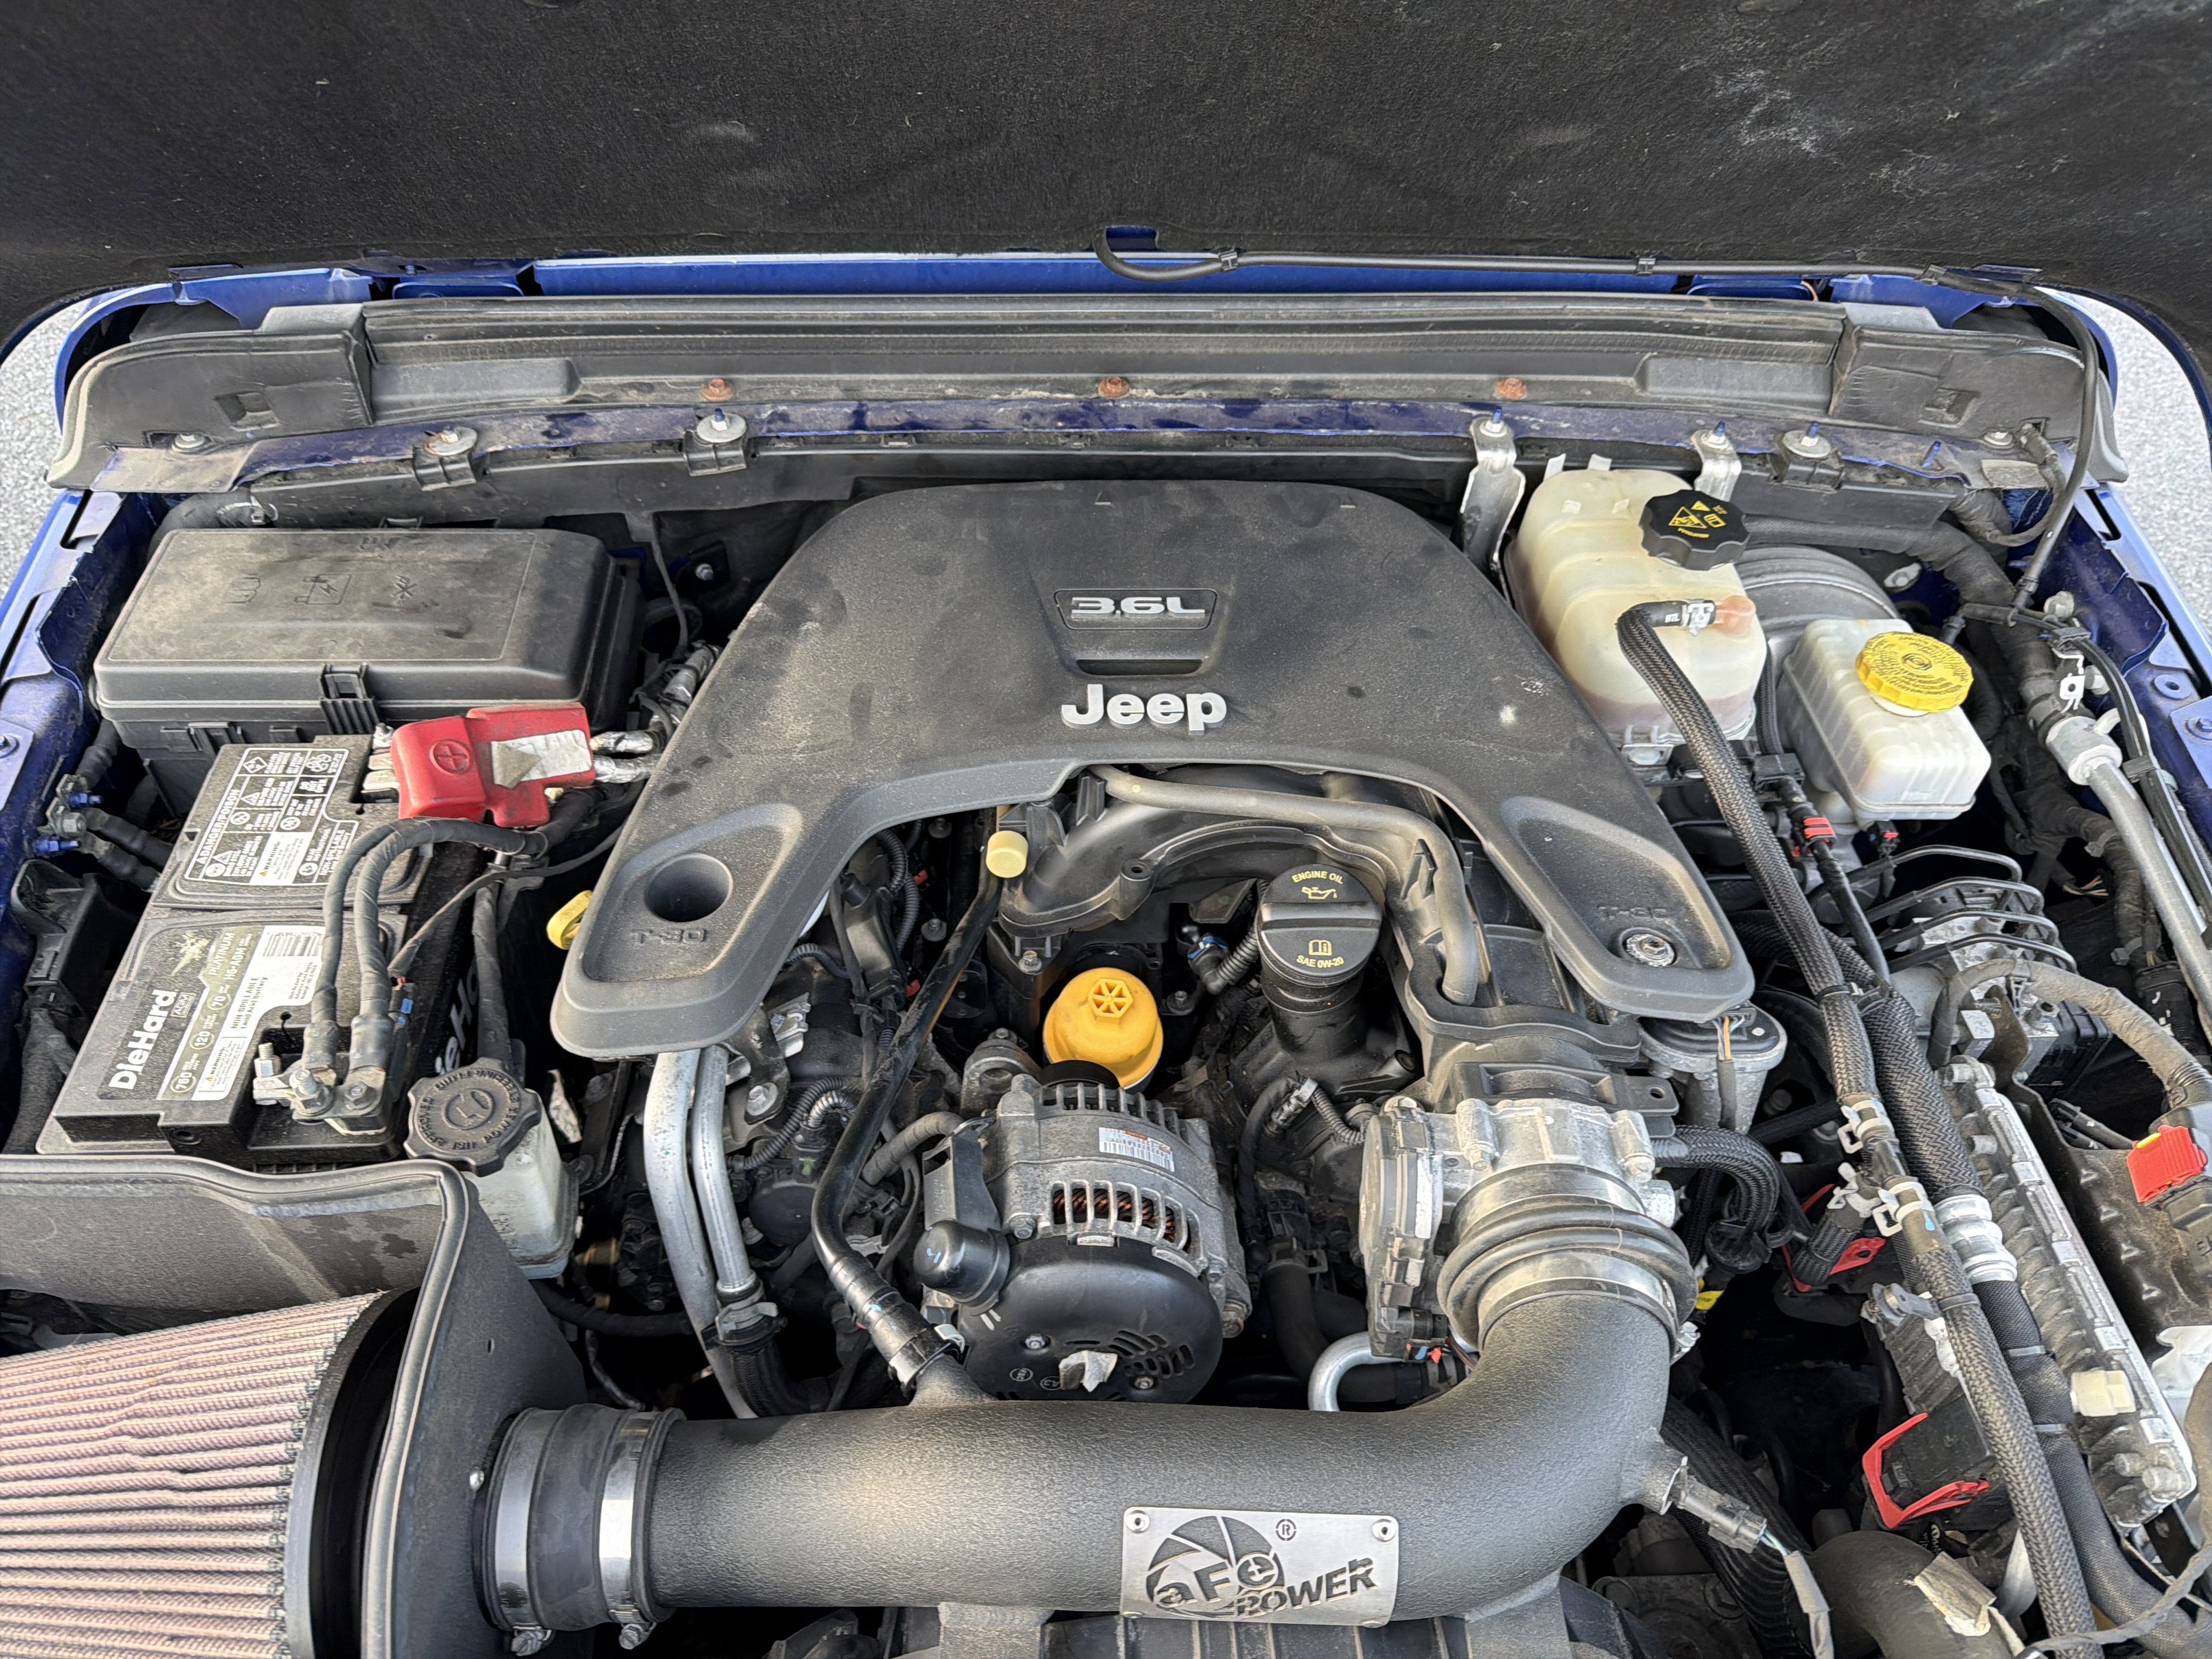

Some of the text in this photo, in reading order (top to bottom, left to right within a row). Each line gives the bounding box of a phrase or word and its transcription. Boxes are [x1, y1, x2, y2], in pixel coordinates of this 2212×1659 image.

[1071, 597, 1205, 616] 3.6L
[1061, 684, 1227, 733] Jeep
[1291, 871, 1344, 884] ENGINE OIL
[207, 932, 236, 975] PLATINUM
[1296, 955, 1344, 968] SAE 0W-20
[211, 995, 227, 1007] 70
[107, 989, 178, 1089] DieHard
[193, 1030, 211, 1046] 120
[1237, 1557, 1379, 1617] POWER
